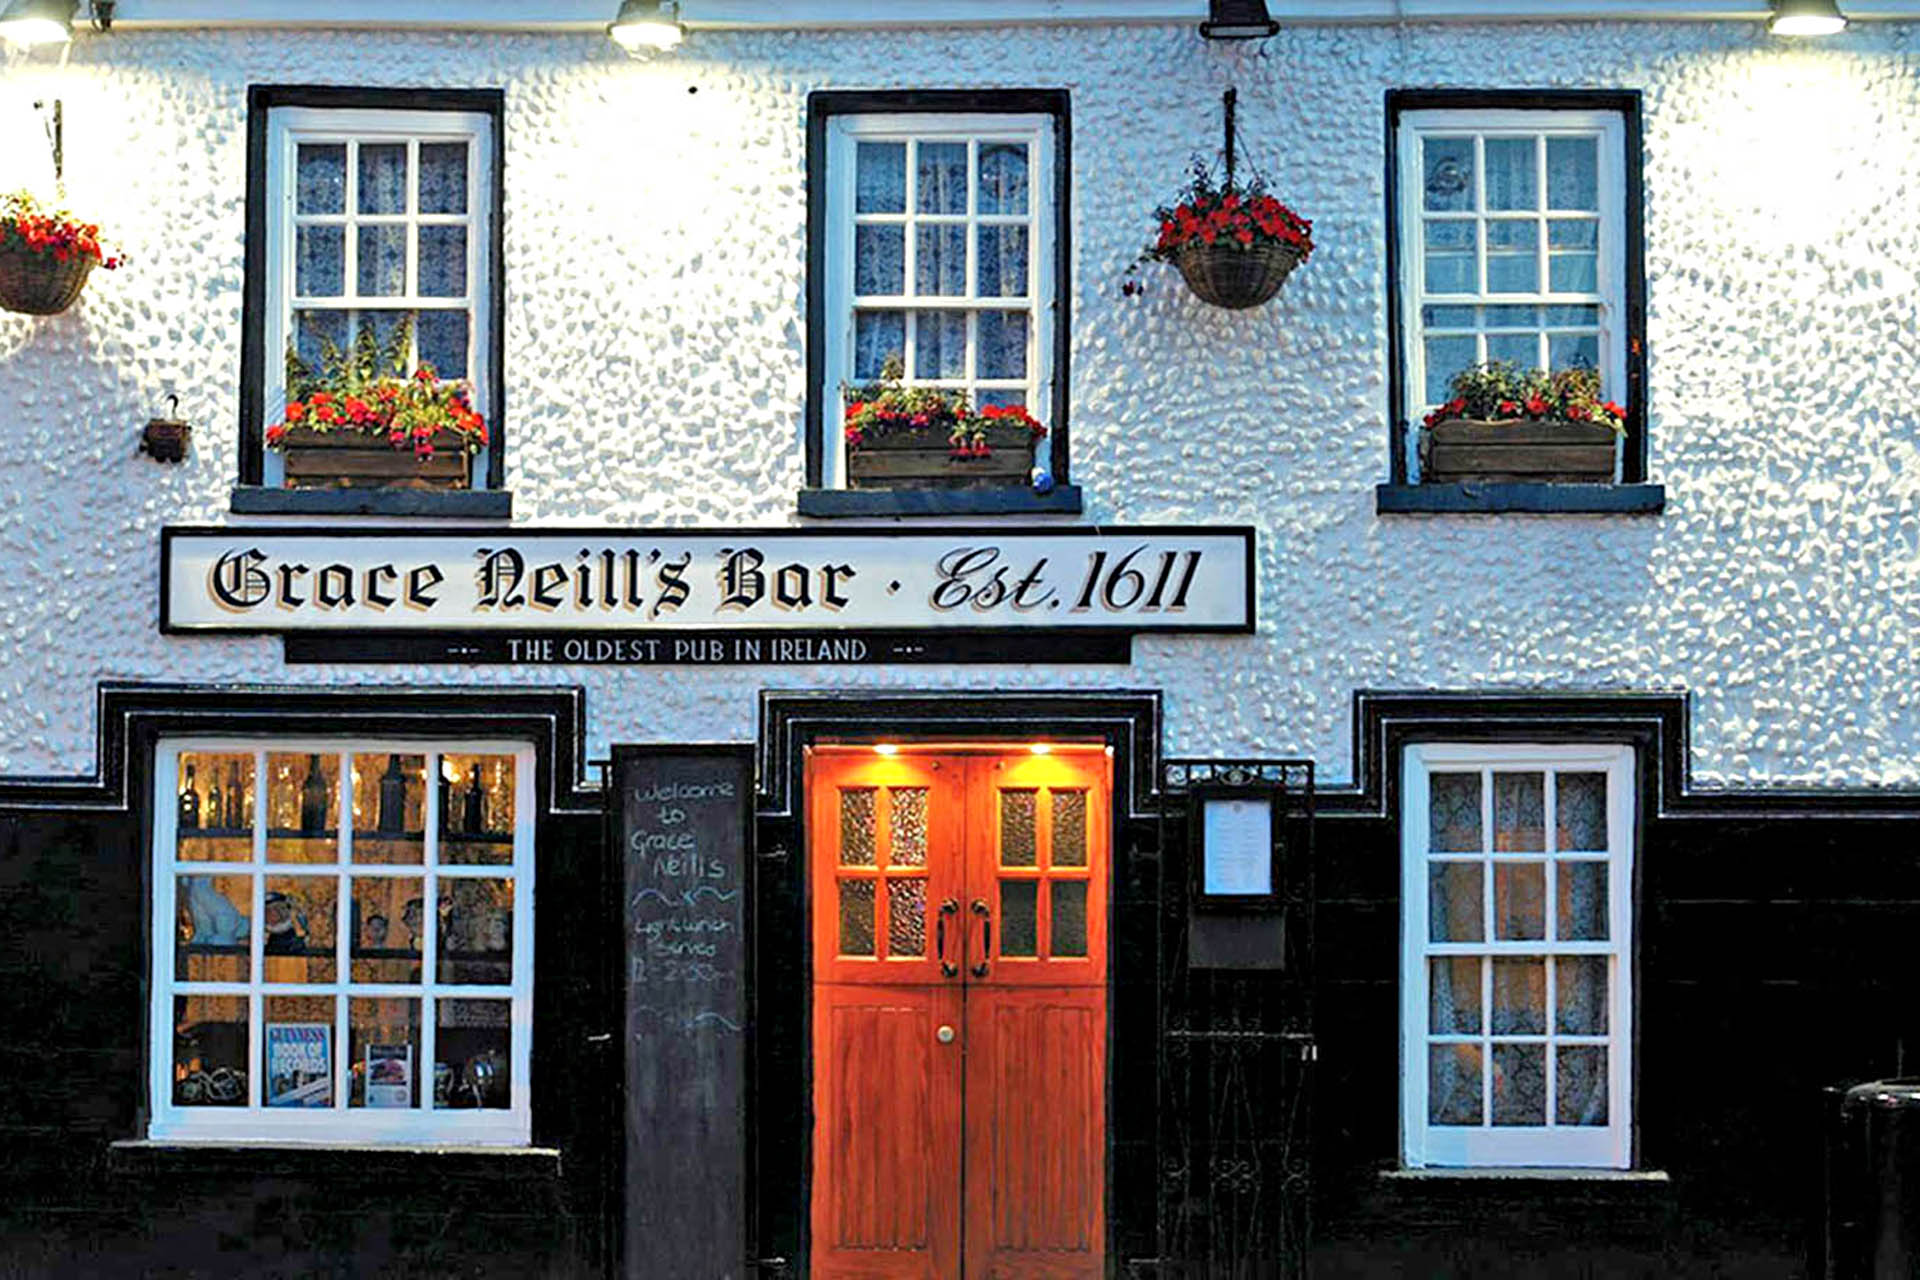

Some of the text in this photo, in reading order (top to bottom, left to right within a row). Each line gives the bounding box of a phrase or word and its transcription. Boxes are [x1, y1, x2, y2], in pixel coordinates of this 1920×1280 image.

[208, 544, 1203, 618] Grace Neill's Bar Est. 1611
[508, 639, 867, 661] THE OLDEST PUB IN IRELAND
[656, 805, 687, 824] to
[630, 829, 695, 859] Grace
